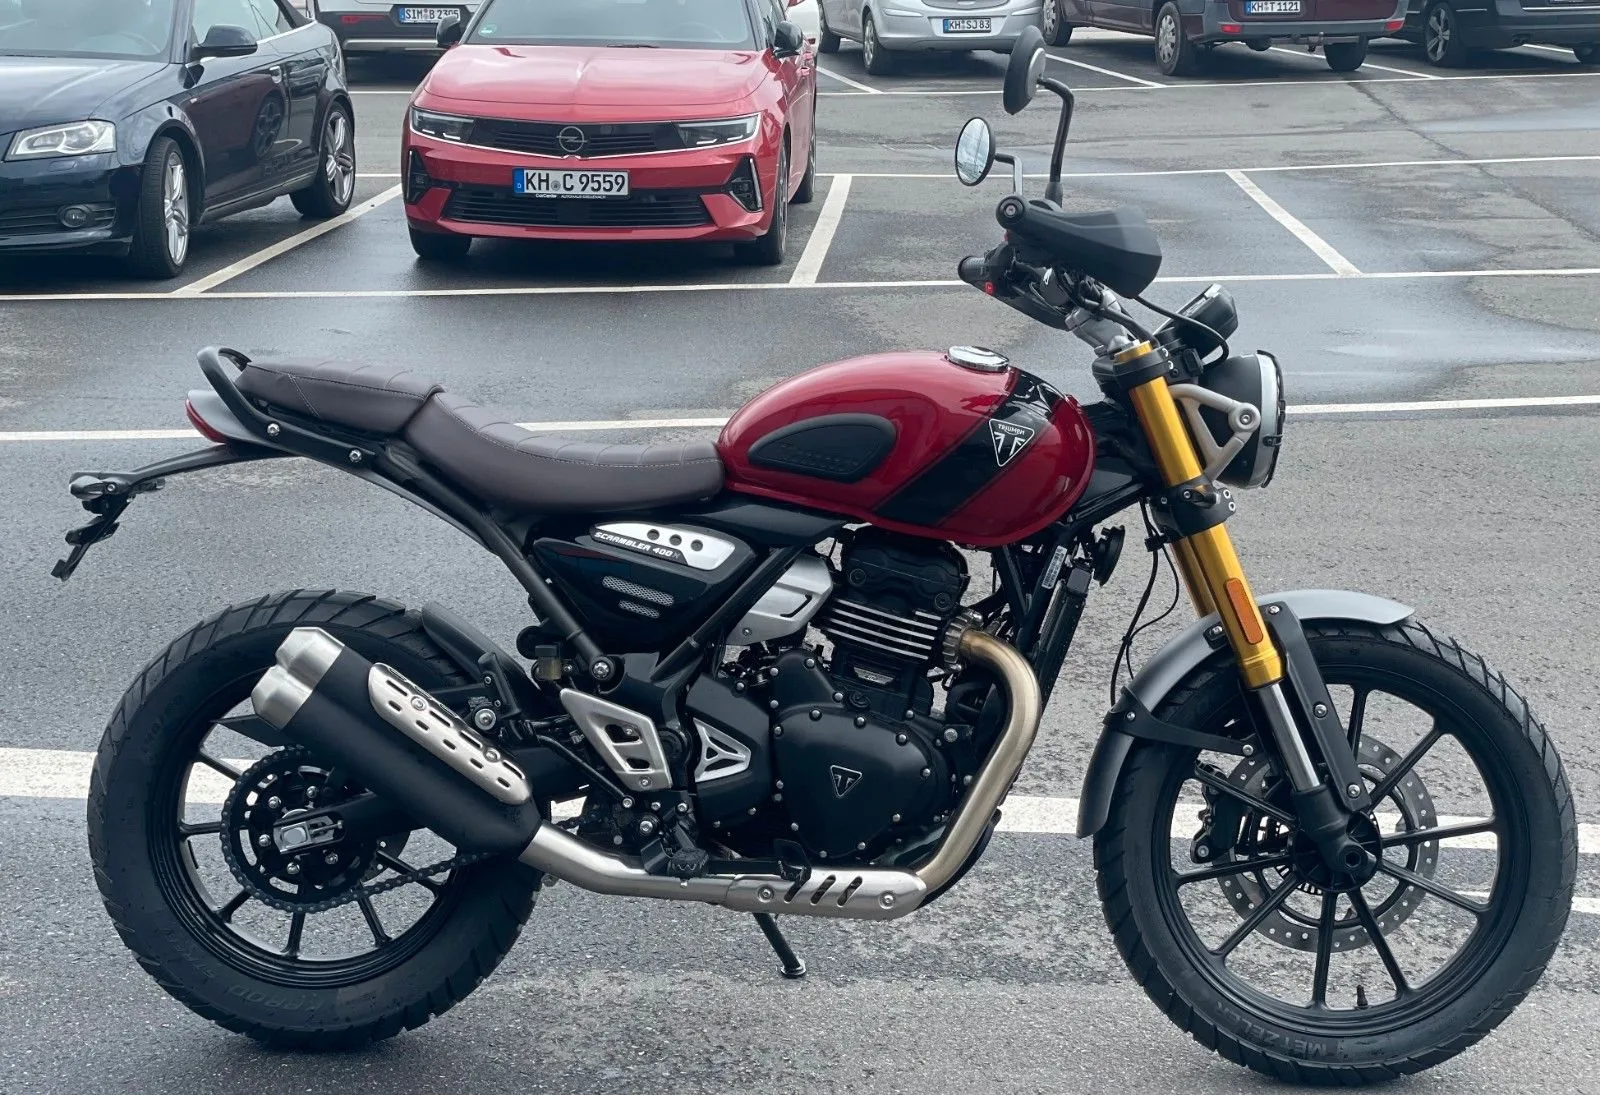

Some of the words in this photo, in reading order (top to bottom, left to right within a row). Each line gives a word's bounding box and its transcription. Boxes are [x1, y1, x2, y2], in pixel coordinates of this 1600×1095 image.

[1252, 2, 1263, 11] KH
[1270, 2, 1275, 11] T
[1277, 2, 1299, 11] 1121
[405, 9, 422, 19] SIM
[429, 9, 435, 19] B
[950, 20, 960, 29] KH
[966, 20, 977, 29] SJ
[979, 20, 990, 29] 83
[525, 171, 550, 191] KH
[562, 173, 574, 191] C
[578, 173, 625, 192] 9559
[998, 423, 1025, 435] TRIUMPH
[594, 531, 652, 552] SCRAMBLER
